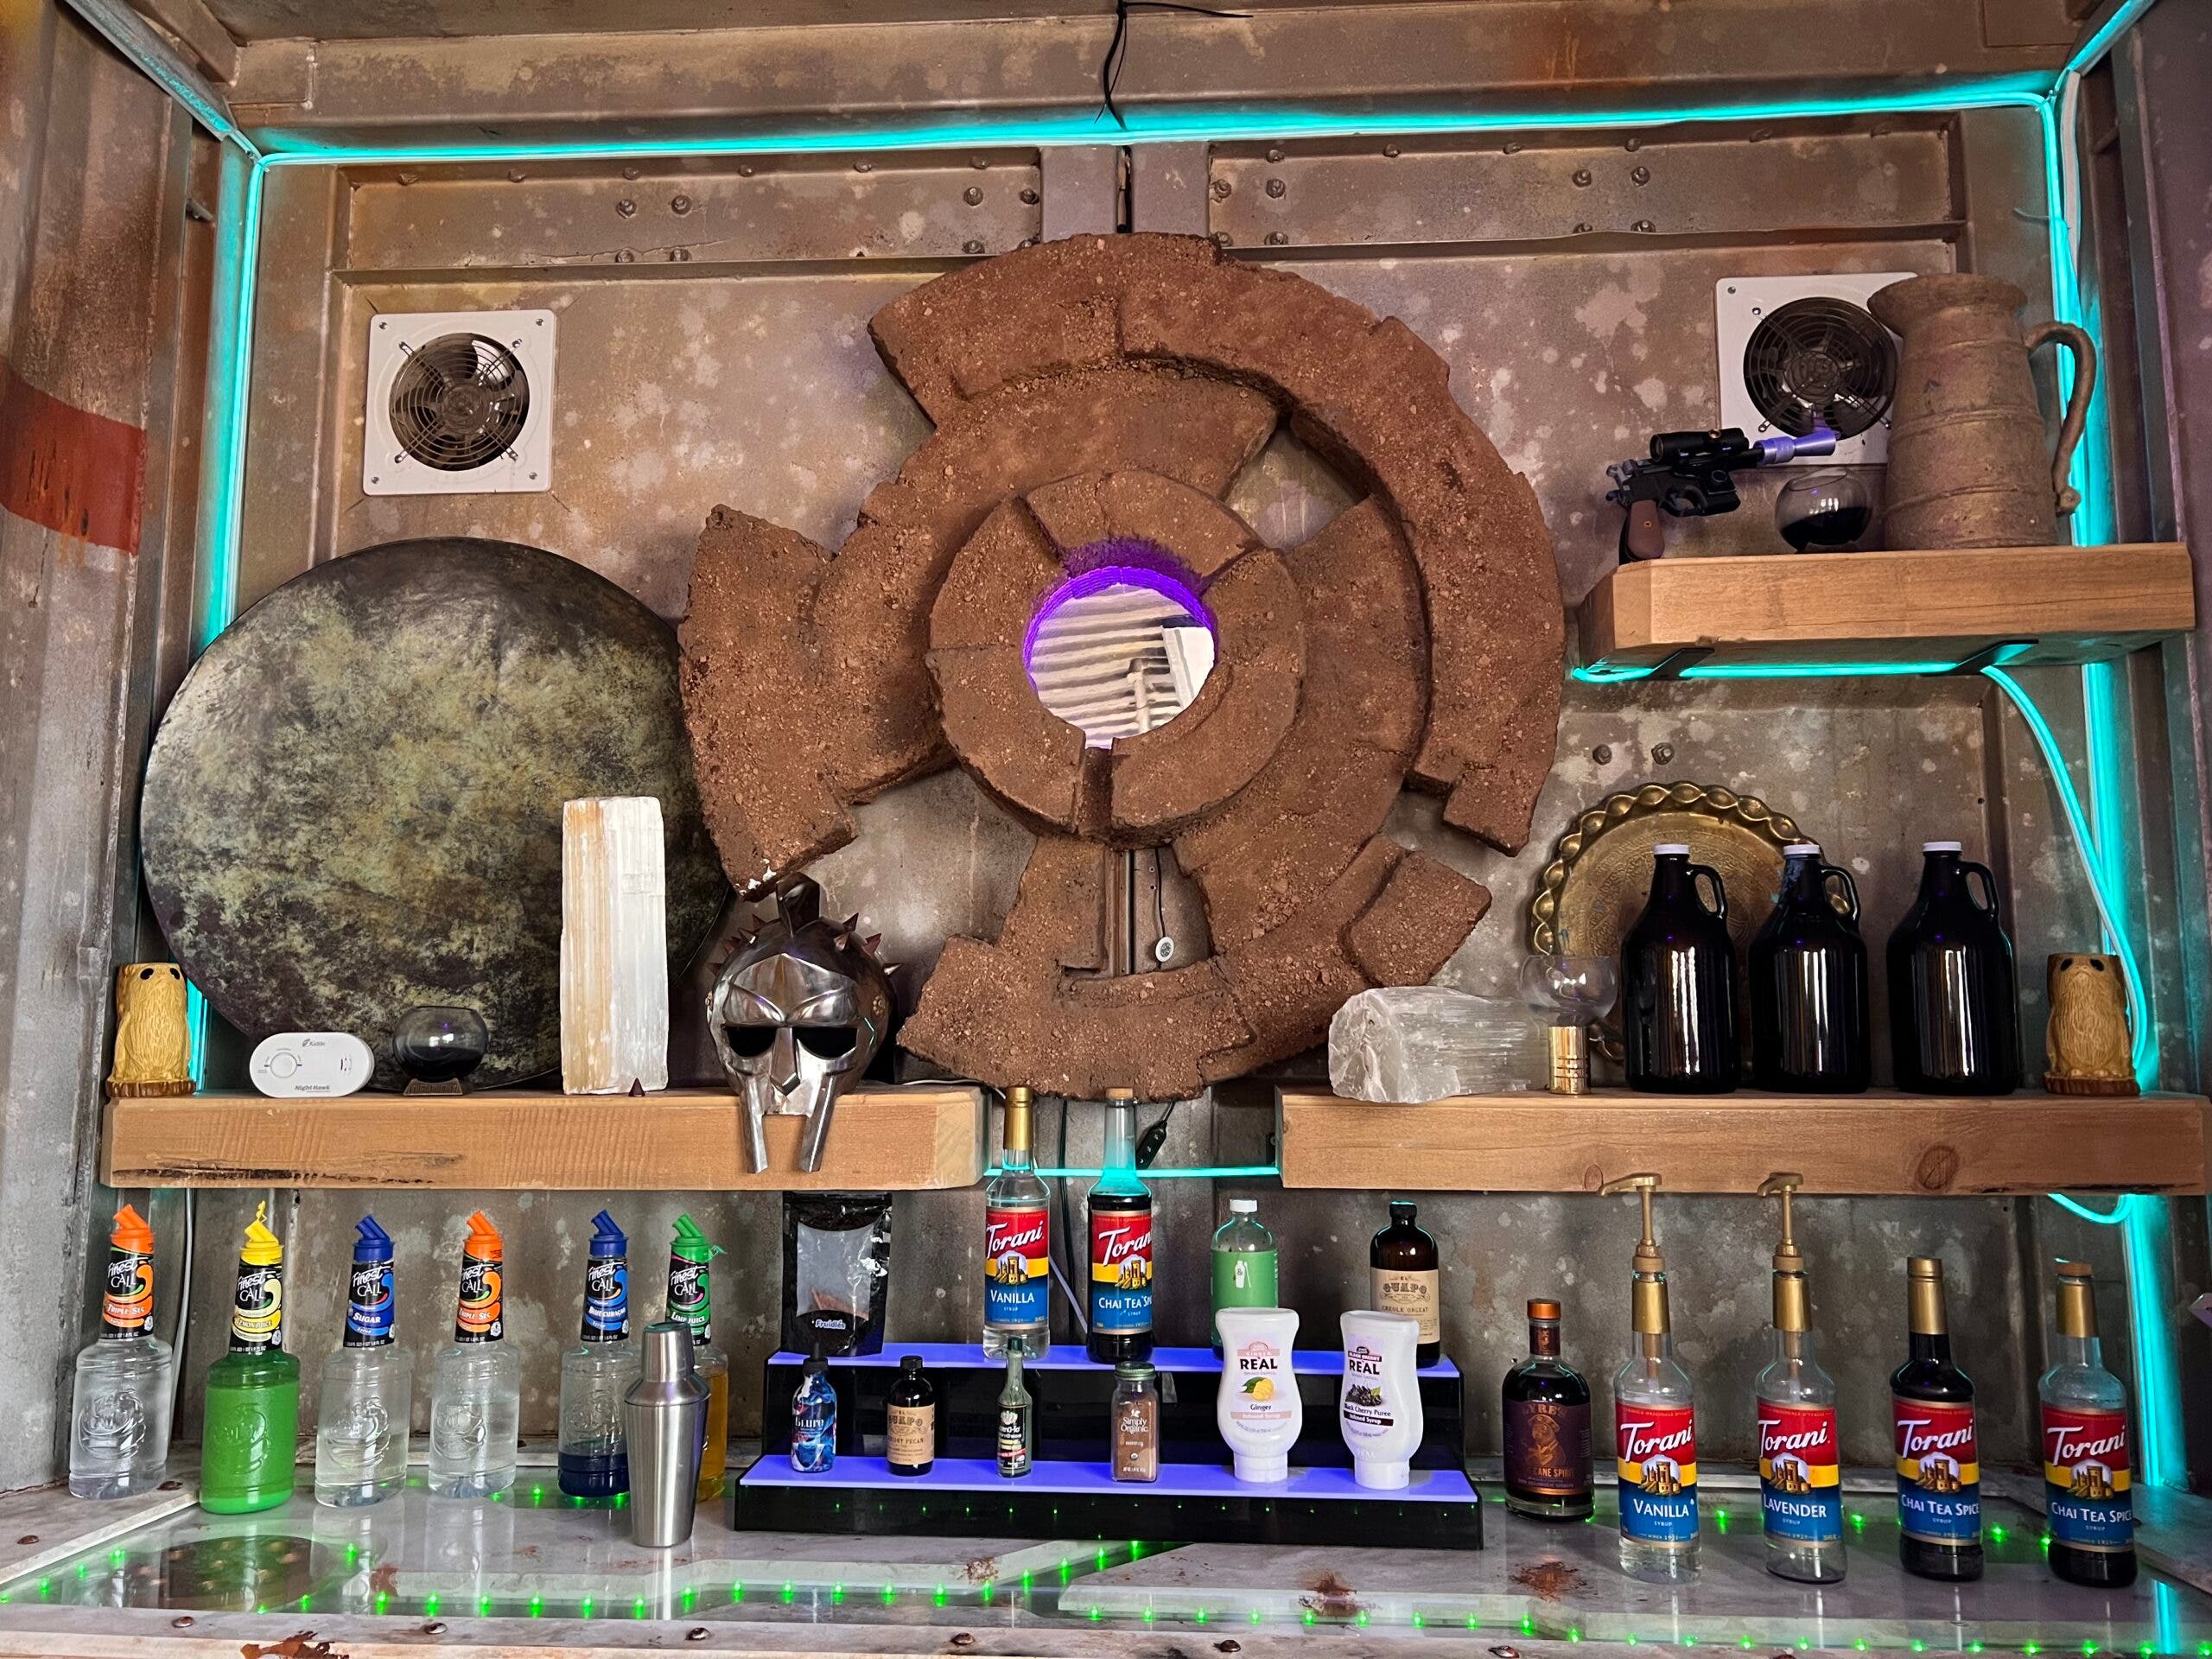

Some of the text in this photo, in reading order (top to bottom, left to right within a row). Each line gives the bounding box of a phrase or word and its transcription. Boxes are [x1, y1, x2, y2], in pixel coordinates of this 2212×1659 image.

[986, 1220, 1044, 1260] Torani
[1099, 1227, 1151, 1267] Toran
[107, 1255, 149, 1278] Finest
[353, 1265, 391, 1287] Finest
[588, 1262, 624, 1281] Finest
[671, 1265, 707, 1286] Finest
[111, 1274, 137, 1287] CALL
[237, 1269, 276, 1291] Finest
[357, 1282, 382, 1297] CALL
[461, 1279, 482, 1294] CALL
[591, 1277, 615, 1291] CALL
[674, 1282, 698, 1296] CALL
[239, 1287, 264, 1301] CALL
[990, 1289, 1034, 1304] VANILLA
[1098, 1297, 1122, 1309] CHAI
[1124, 1298, 1141, 1308] TEA
[353, 1312, 381, 1324] SUGAR
[671, 1312, 705, 1324] LIME JUICE
[1355, 1406, 1372, 1416] Cherry
[1120, 1424, 1148, 1434] Organic
[1122, 1417, 1147, 1426] Simply
[1366, 1417, 1382, 1426] Syrup
[1620, 1419, 1693, 1462] Torani
[1758, 1420, 1827, 1458] Torani
[1897, 1419, 1974, 1459] Torani
[2047, 1424, 2126, 1466] Torani
[1633, 1498, 1689, 1517] VANILLA
[1764, 1493, 1827, 1518] LAVENDER
[1901, 1494, 1980, 1516] CHAI TEA SPICE
[2051, 1502, 2133, 1522] CHAI TEA SPICE
